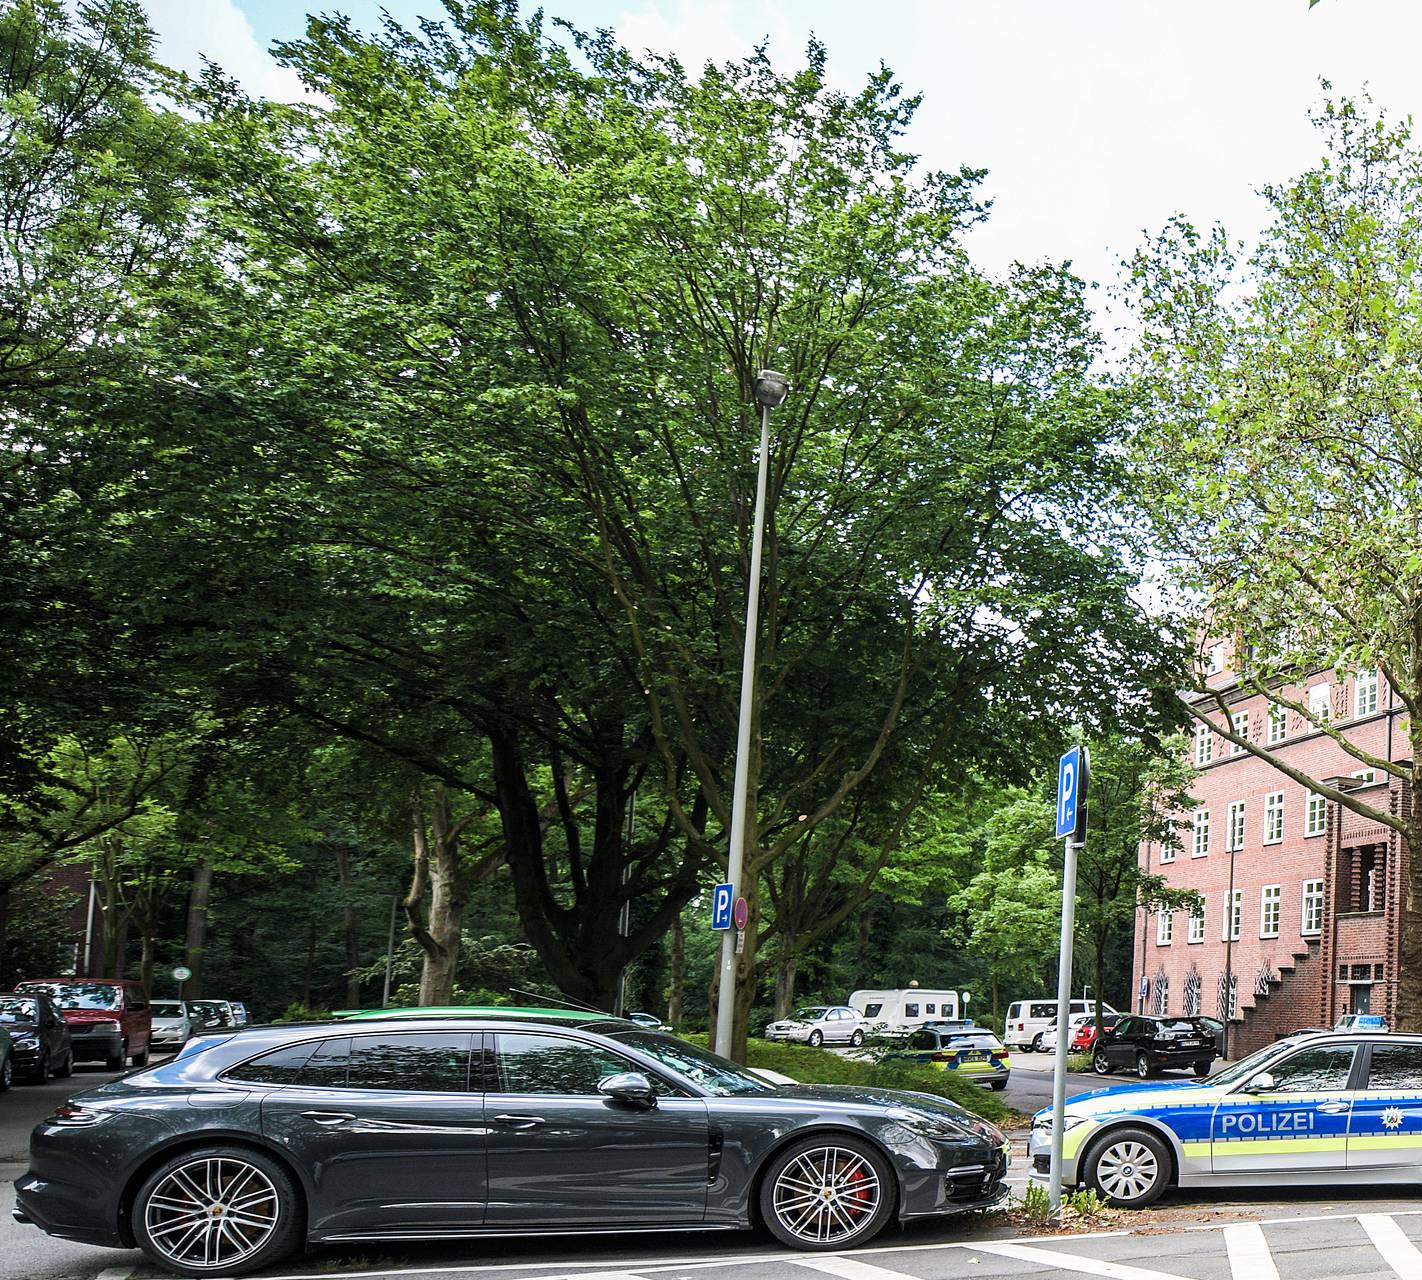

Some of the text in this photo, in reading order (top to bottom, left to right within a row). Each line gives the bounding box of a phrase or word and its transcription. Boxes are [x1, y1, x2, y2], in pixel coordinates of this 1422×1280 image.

[1061, 763, 1074, 826] P
[716, 890, 728, 923] P
[1222, 1112, 1314, 1133] POLIZEI
